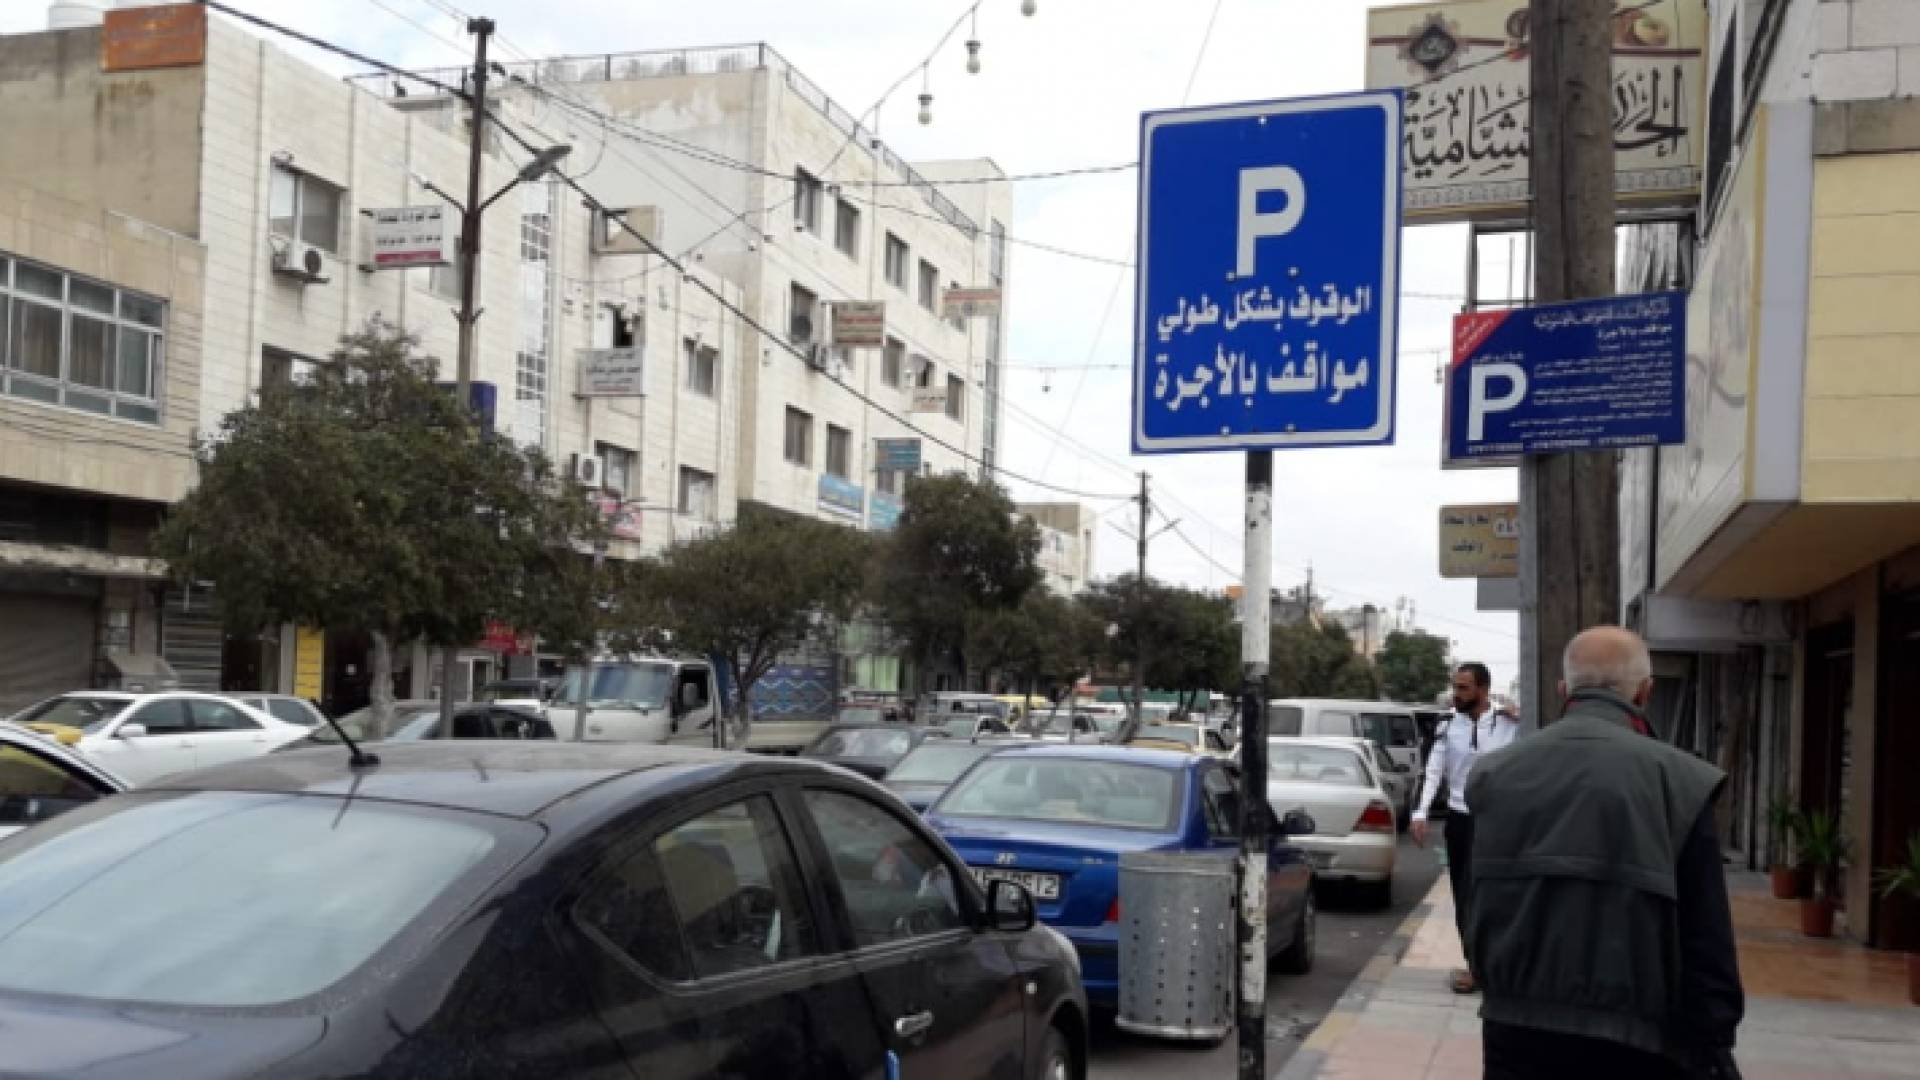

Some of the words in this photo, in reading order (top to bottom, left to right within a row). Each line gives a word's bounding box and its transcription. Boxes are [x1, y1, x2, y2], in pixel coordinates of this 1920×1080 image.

[1236, 165, 1306, 277] P
[1157, 294, 1220, 342] طولي
[1224, 285, 1284, 331] بشكل
[1289, 283, 1371, 327] الوقوف
[1267, 341, 1369, 403] مواقف
[1466, 362, 1529, 442] P
